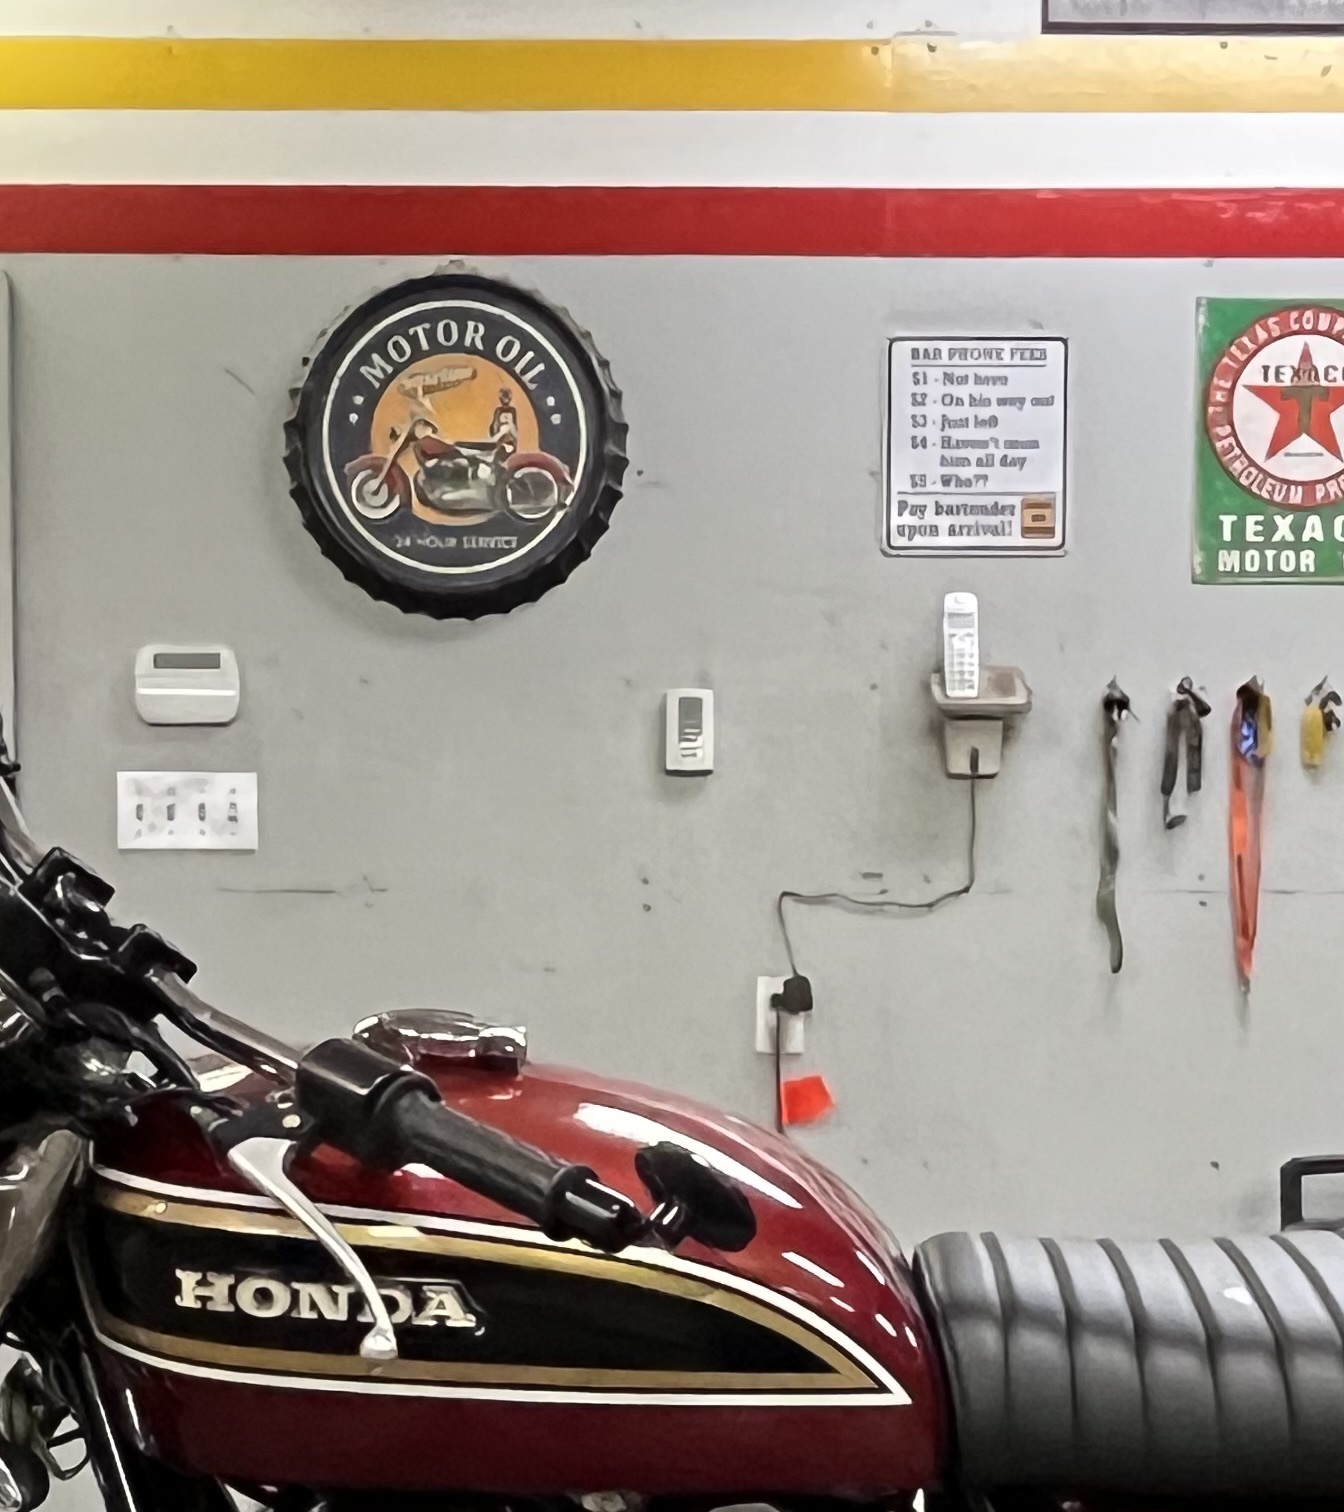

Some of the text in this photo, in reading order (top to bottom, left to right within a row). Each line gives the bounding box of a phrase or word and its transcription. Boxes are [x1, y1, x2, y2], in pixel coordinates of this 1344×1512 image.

[359, 319, 548, 390] MOTOR OIL
[1214, 424, 1303, 504] PETROLEUM
[897, 499, 1016, 519] Pay bartender
[1217, 549, 1316, 573] MOTOR
[174, 1268, 477, 1328] HONDA
